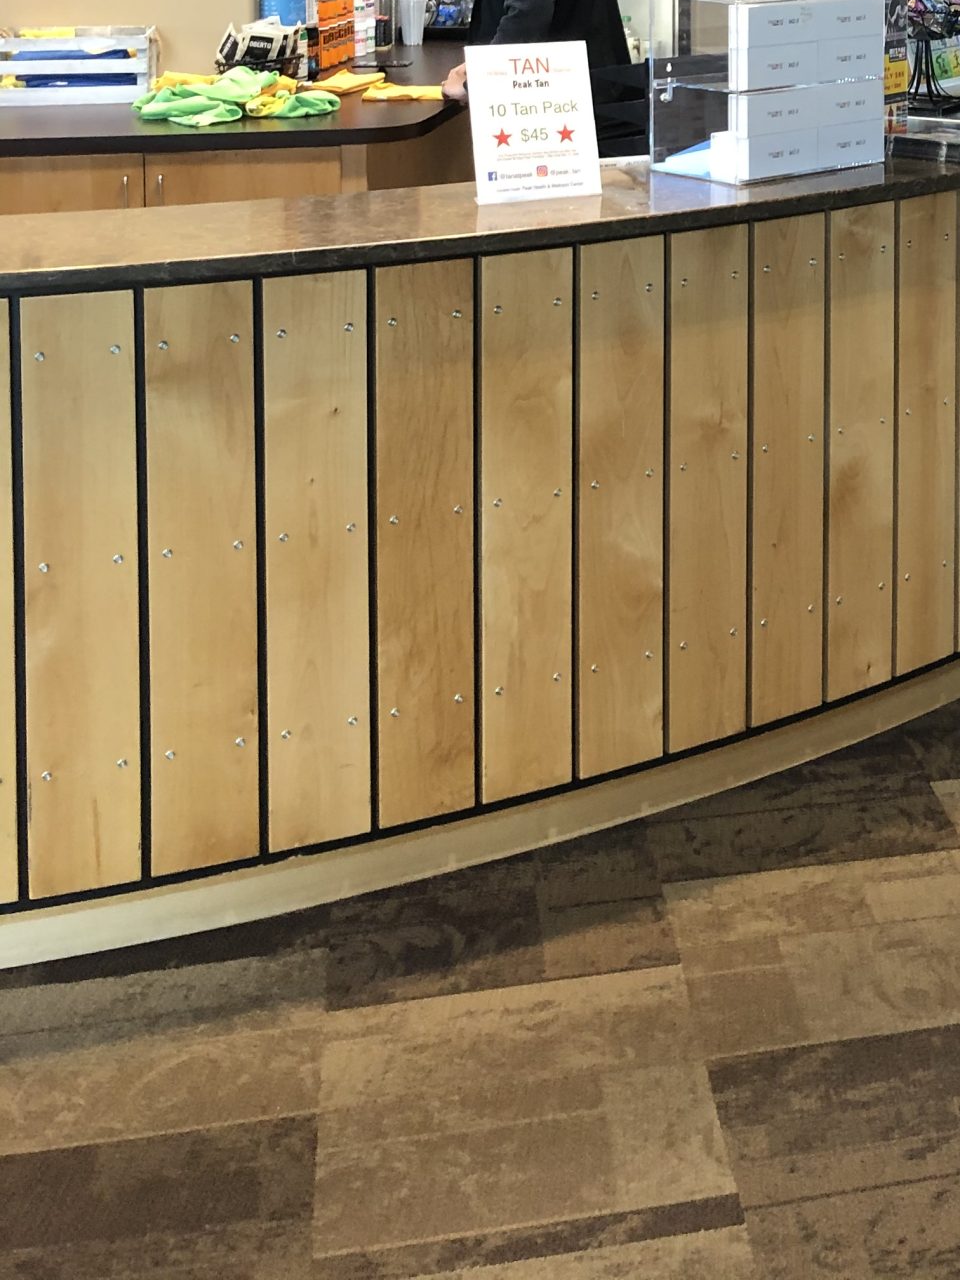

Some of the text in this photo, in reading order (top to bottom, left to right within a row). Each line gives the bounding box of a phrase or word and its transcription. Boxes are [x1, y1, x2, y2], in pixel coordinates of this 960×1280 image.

[249, 40, 272, 49] OBERTO
[508, 57, 550, 75] TAN
[512, 79, 550, 89] Peak Tan
[489, 100, 578, 117] 10 Tan Pack
[520, 128, 548, 143] $45
